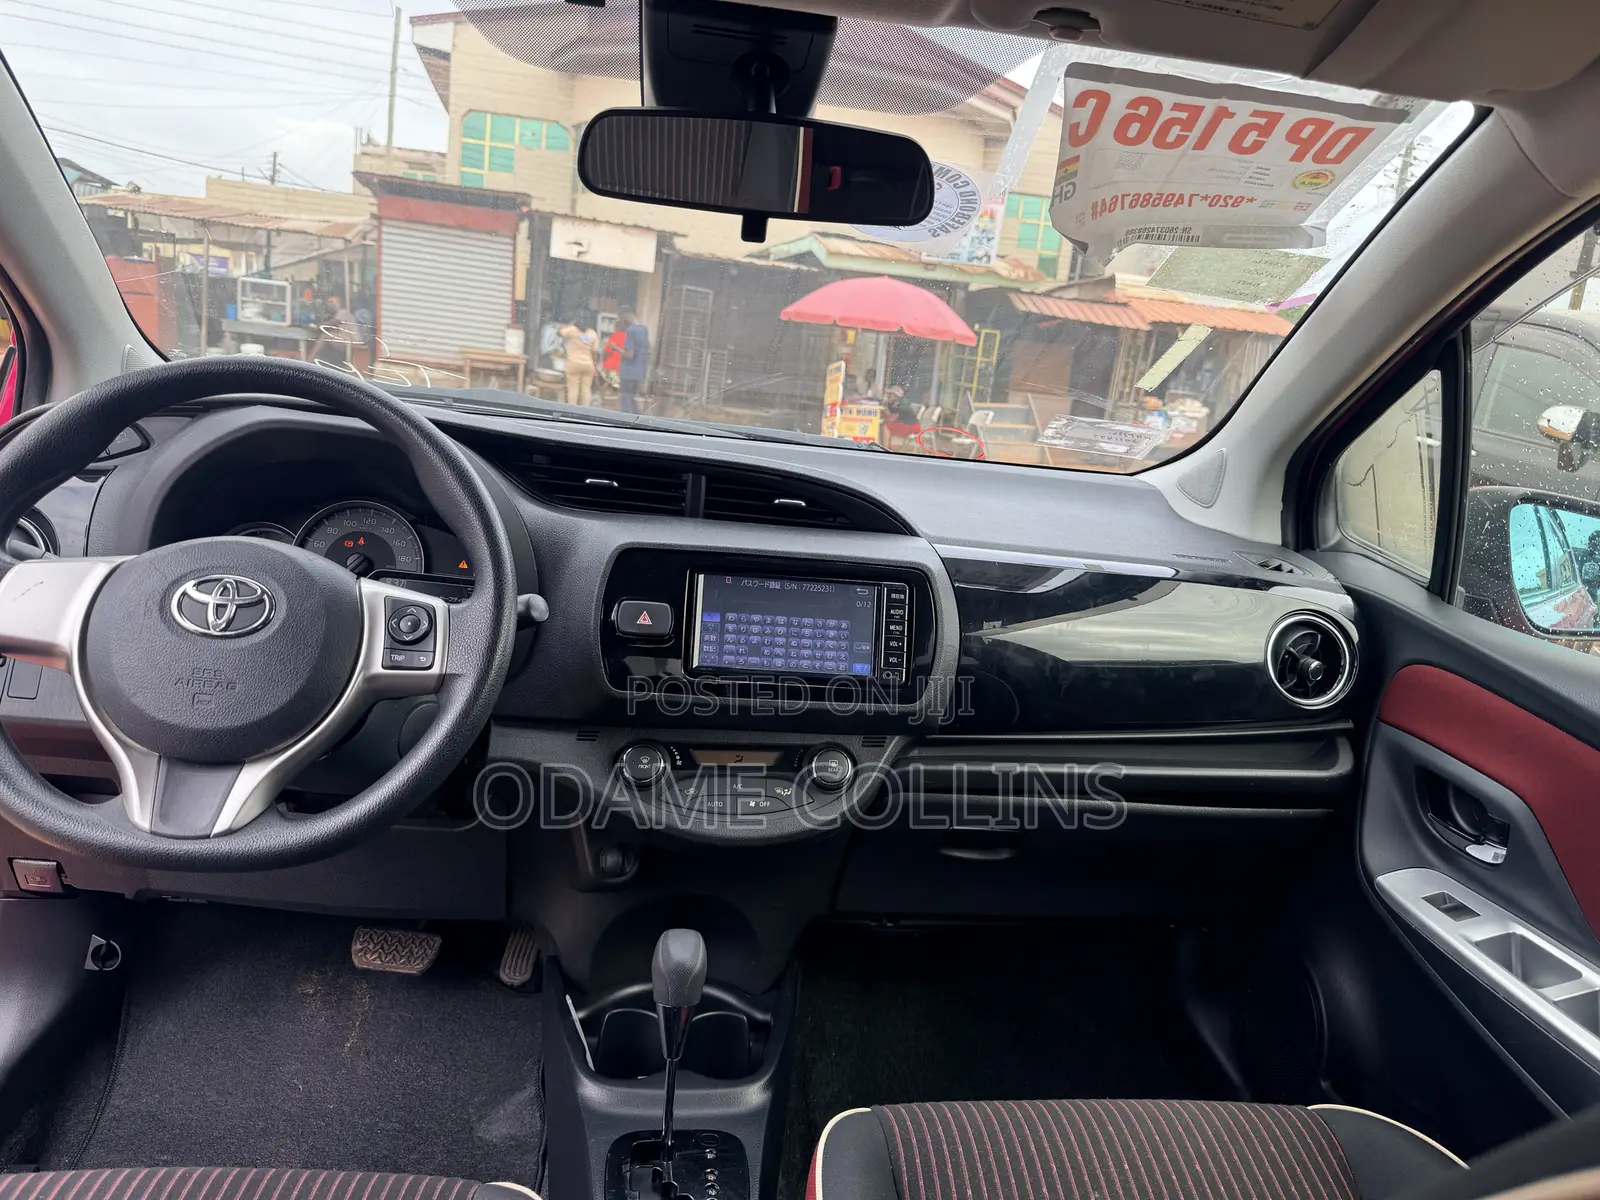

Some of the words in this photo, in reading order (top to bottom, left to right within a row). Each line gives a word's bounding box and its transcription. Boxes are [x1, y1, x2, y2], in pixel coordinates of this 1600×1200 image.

[363, 518, 377, 526] 120
[326, 527, 339, 535] 80
[381, 526, 395, 536] 140
[313, 540, 326, 549] 60
[392, 539, 406, 548] 160
